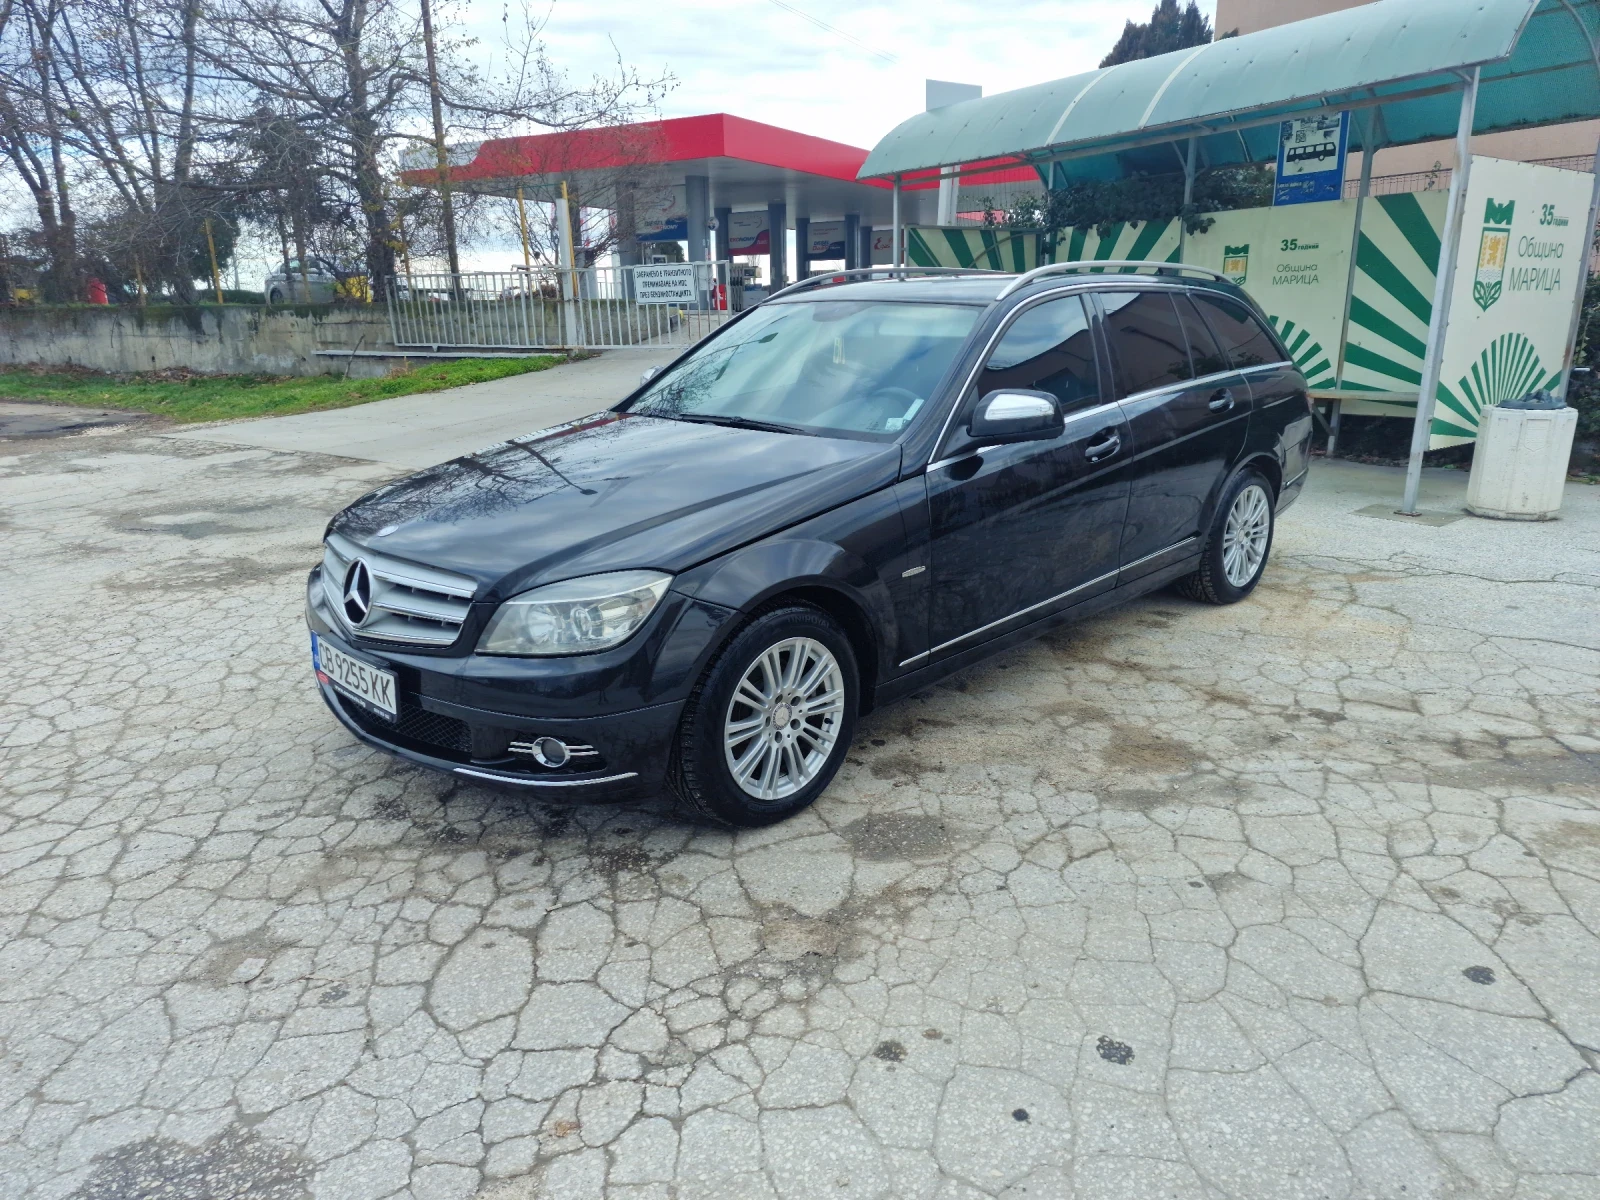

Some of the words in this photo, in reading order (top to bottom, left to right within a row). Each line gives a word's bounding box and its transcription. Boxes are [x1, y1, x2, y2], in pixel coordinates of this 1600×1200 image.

[1540, 204, 1555, 226] 35
[1280, 239, 1298, 251] 35
[1518, 236, 1564, 261] Община
[1272, 274, 1319, 285] МАРИЦА
[1276, 264, 1318, 273] Община
[1508, 267, 1561, 294] МАРИЦА
[318, 642, 335, 675] CB
[335, 653, 369, 695] 9255
[369, 670, 393, 708] KK
